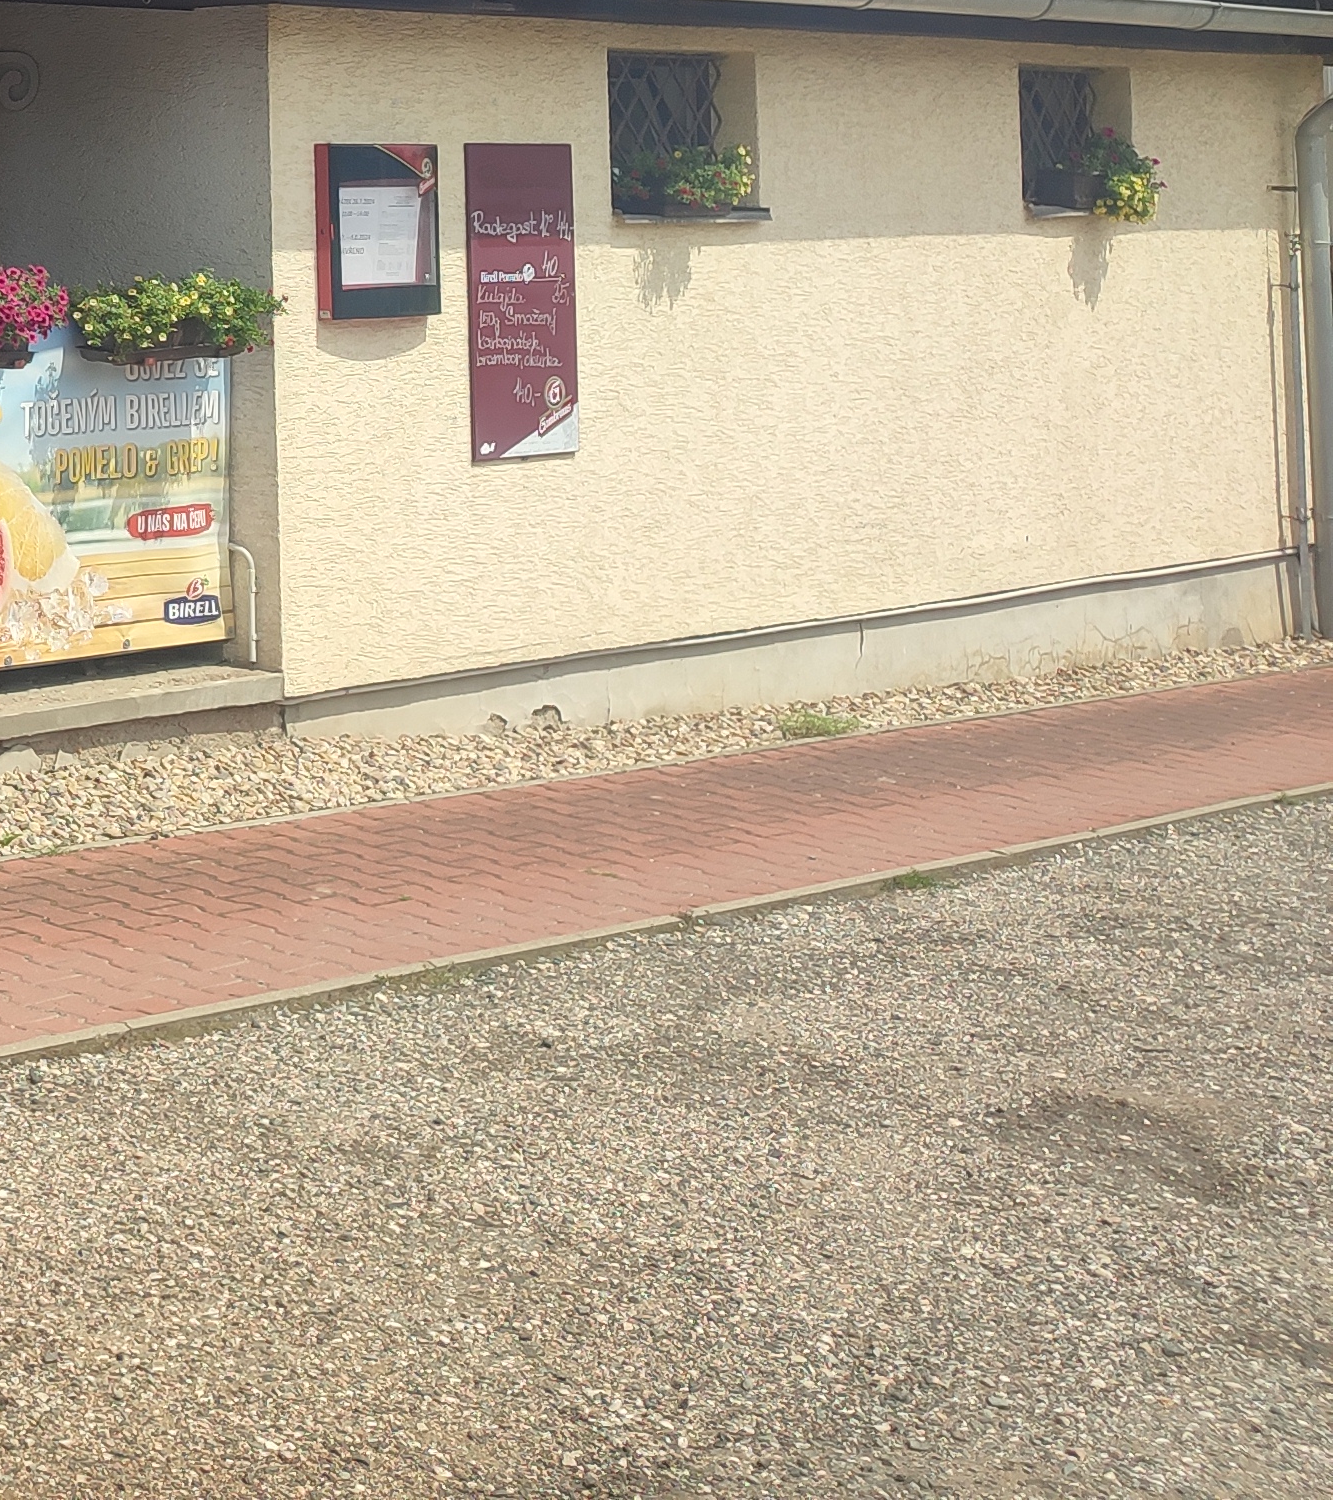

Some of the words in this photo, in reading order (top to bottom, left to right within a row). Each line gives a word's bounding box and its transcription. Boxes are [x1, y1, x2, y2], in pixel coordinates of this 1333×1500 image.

[471, 210, 538, 243] Radegast
[477, 284, 526, 311] Kulajda
[505, 306, 557, 335] Smažený
[20, 388, 117, 440] TOČENÝM
[125, 389, 220, 431] BIRELLEM
[55, 442, 138, 485] POMELO
[144, 449, 160, 477] &
[166, 436, 219, 476] GREP!
[137, 515, 145, 533] U
[147, 510, 170, 532] NÁS
[173, 512, 188, 531] NA
[188, 507, 206, 529] ČEPU
[169, 600, 220, 620] BIRELL
